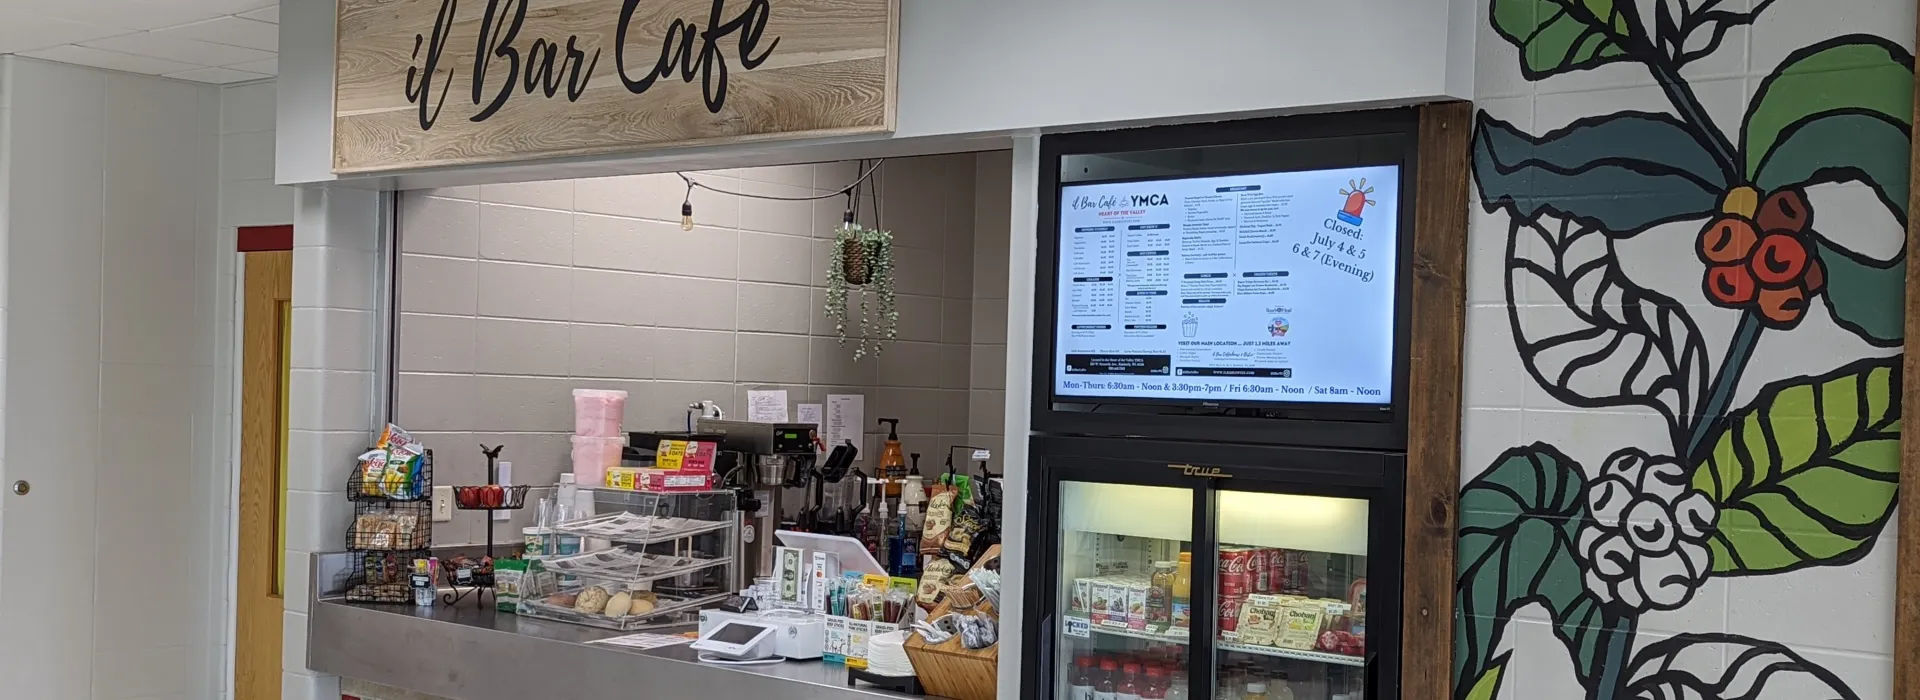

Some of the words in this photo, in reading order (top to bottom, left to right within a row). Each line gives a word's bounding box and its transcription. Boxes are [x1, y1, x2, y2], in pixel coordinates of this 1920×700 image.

[405, 0, 459, 131] il
[469, 0, 601, 122] Bar
[1081, 196, 1097, 210] Bar
[1130, 194, 1169, 207] YMCA
[1324, 218, 1364, 240] Closed:
[1310, 232, 1336, 250] July
[1337, 242, 1345, 252] 4
[1346, 244, 1356, 256] &
[1358, 248, 1366, 259] 5
[1292, 243, 1300, 254] 6
[1301, 246, 1311, 258] &
[1313, 250, 1321, 260] 7
[1320, 253, 1374, 282] (Evening)
[1063, 381, 1106, 389] Mon-Thurs:
[1107, 382, 1134, 390] 6:30am
[1142, 382, 1162, 390] Noon
[1172, 384, 1222, 394] 3:30pm-7pm
[1243, 385, 1273, 393] 6:30am
[1314, 386, 1327, 394] Sat
[1329, 386, 1348, 395] 8am
[1356, 387, 1381, 395] Noon
[1250, 608, 1276, 616] Chobani
[1290, 611, 1316, 619] Chobani
